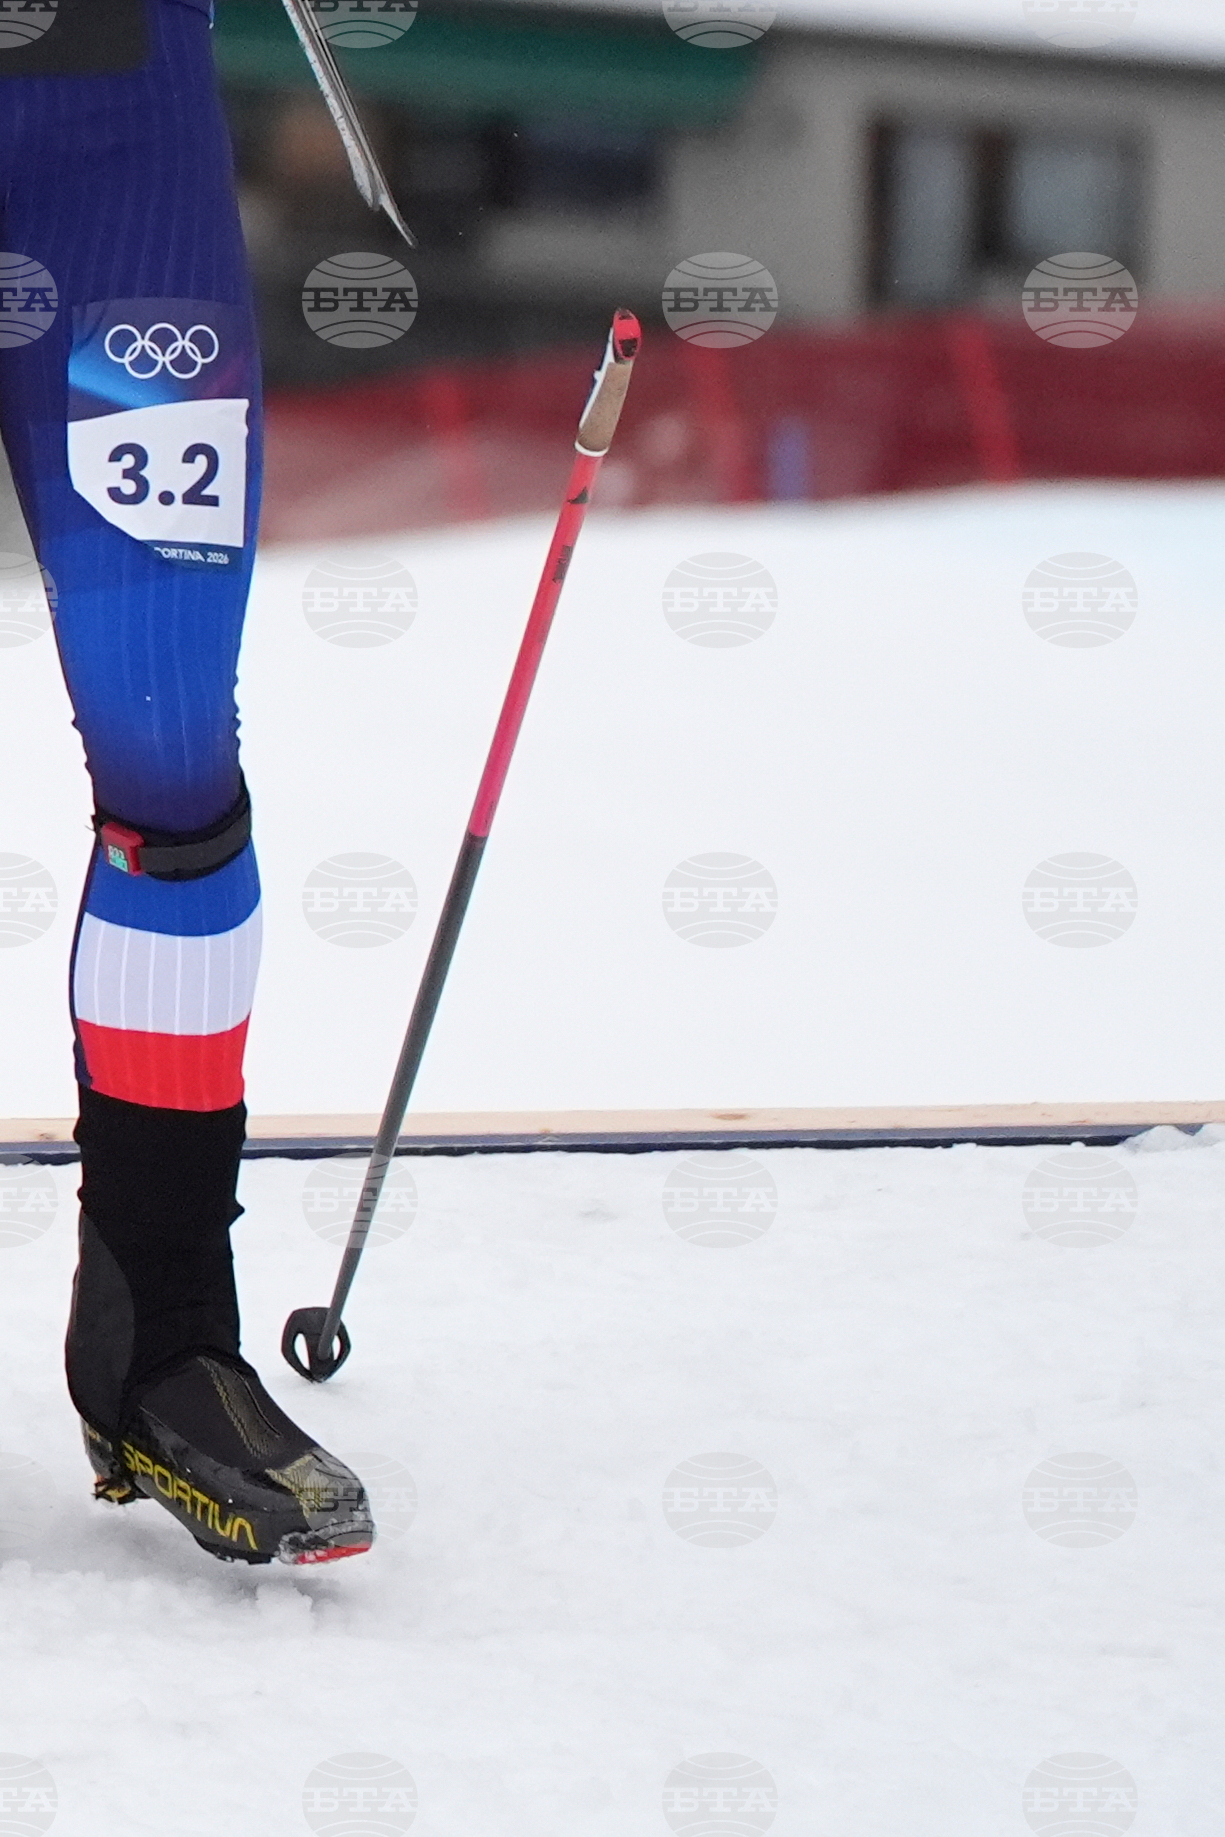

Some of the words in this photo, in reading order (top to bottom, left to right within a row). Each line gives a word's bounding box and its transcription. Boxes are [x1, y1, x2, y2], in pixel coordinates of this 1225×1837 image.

[106, 442, 220, 508] 3.2
[206, 551, 230, 565] 2026
[121, 1440, 259, 1551] SPORTIVA
